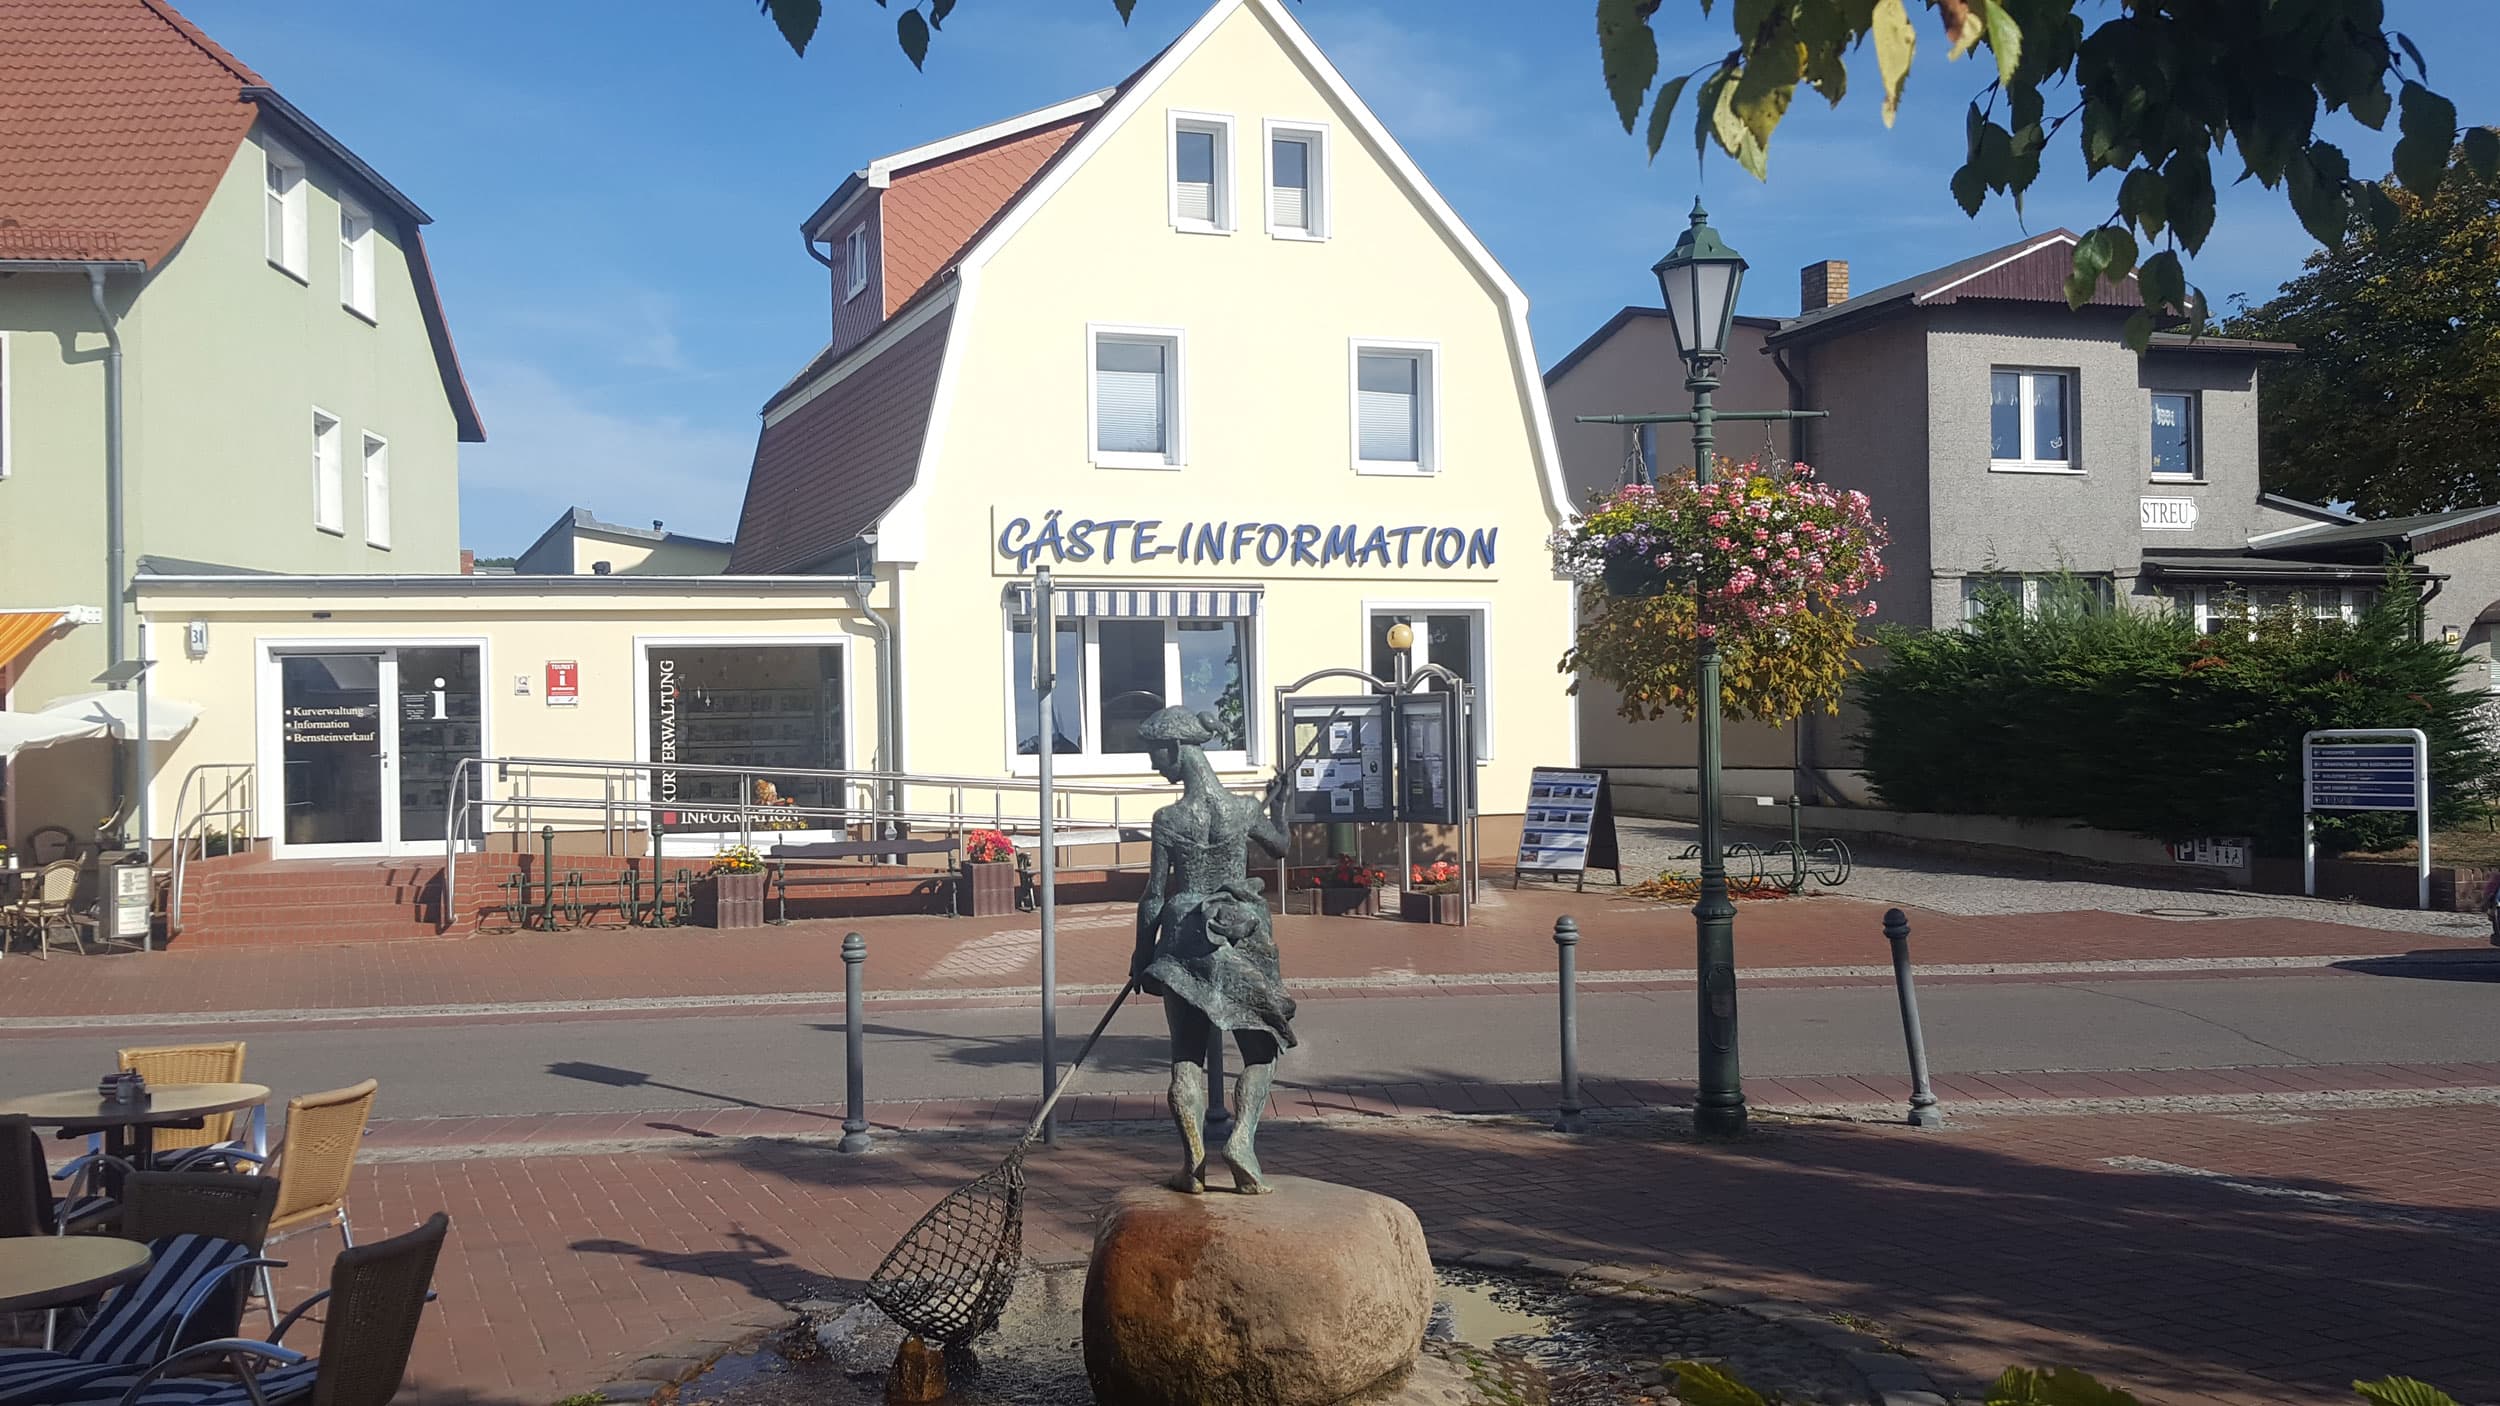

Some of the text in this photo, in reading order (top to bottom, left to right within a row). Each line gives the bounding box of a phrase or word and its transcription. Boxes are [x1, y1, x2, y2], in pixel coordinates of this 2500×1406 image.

[2142, 502, 2188, 523] STREU
[999, 509, 1498, 572] GÄSTE-INFORMATION
[293, 706, 364, 717] Kurverwaltung
[293, 720, 350, 729] Information
[660, 660, 677, 805] KURERWALTUNG
[293, 732, 376, 742] Bernsteinverkauf
